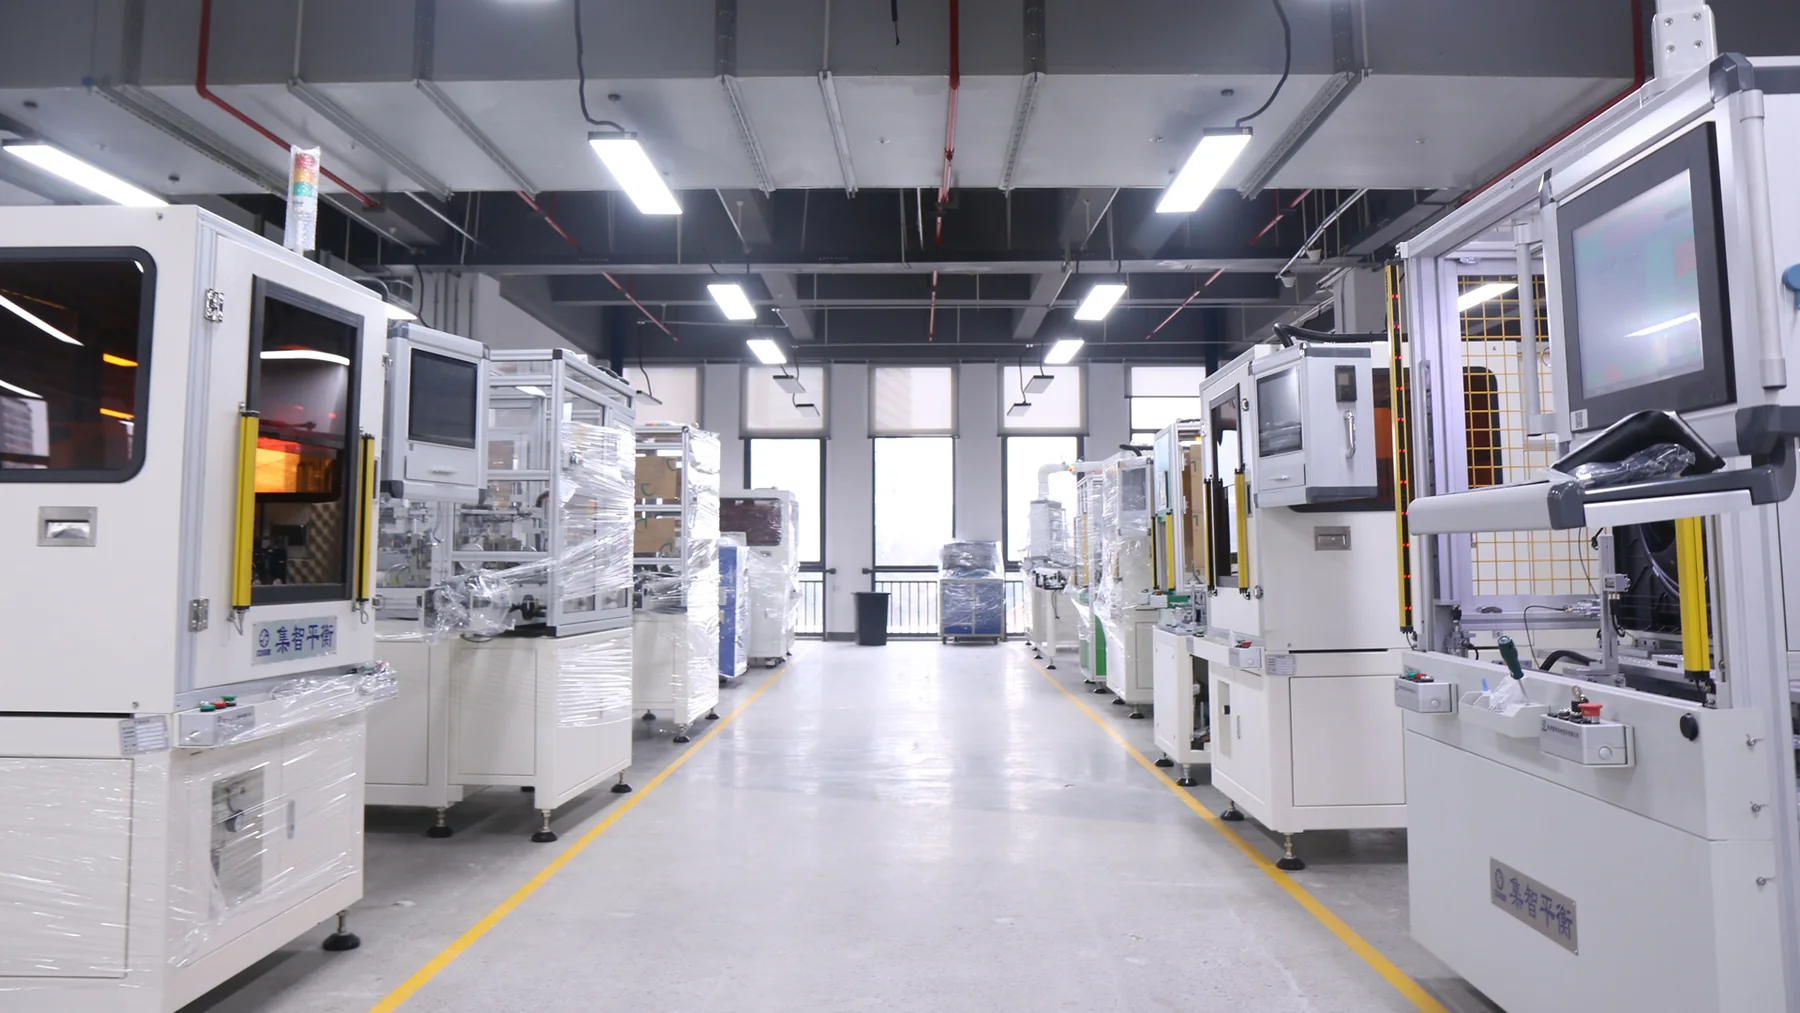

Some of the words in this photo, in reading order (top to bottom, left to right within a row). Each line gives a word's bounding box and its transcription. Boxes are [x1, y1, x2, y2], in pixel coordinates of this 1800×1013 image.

[275, 624, 334, 654] 集智平衡
[1508, 876, 1573, 941] 集智平衡
